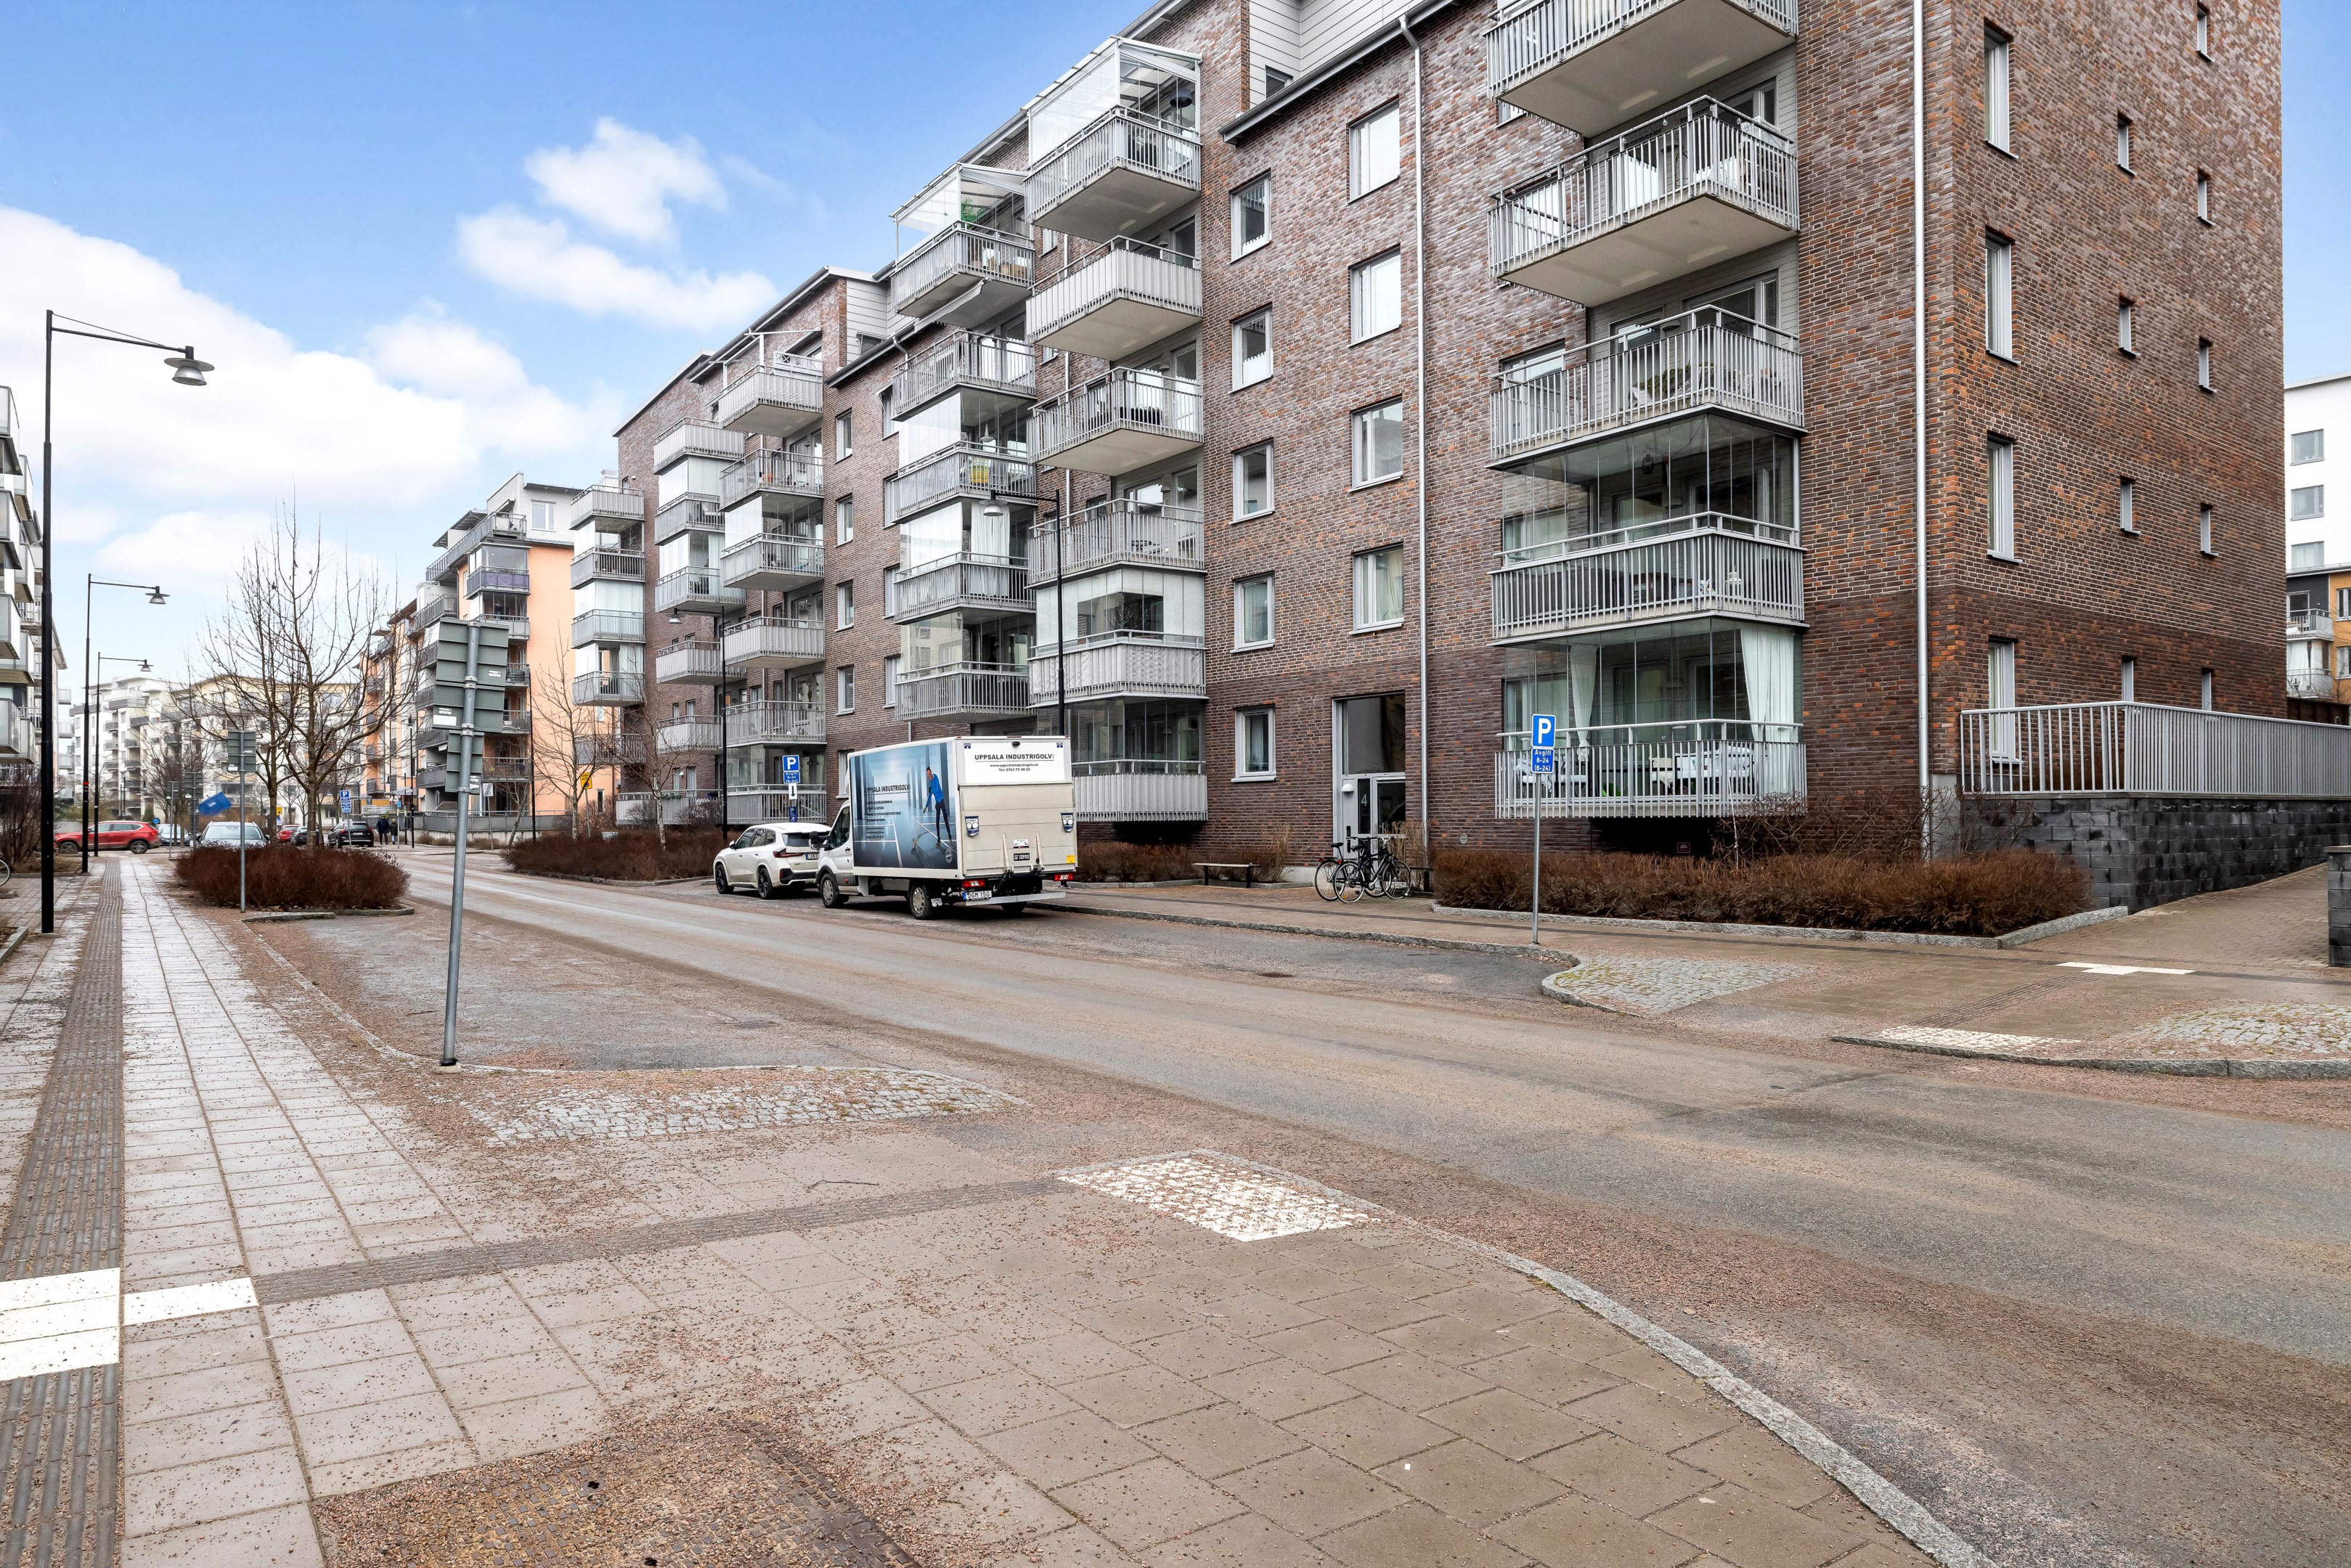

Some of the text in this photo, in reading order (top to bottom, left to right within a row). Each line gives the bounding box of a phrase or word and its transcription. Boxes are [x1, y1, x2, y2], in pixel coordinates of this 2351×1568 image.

[1538, 718, 1552, 744] P
[786, 757, 796, 770] P
[1361, 793, 1368, 807] 4
